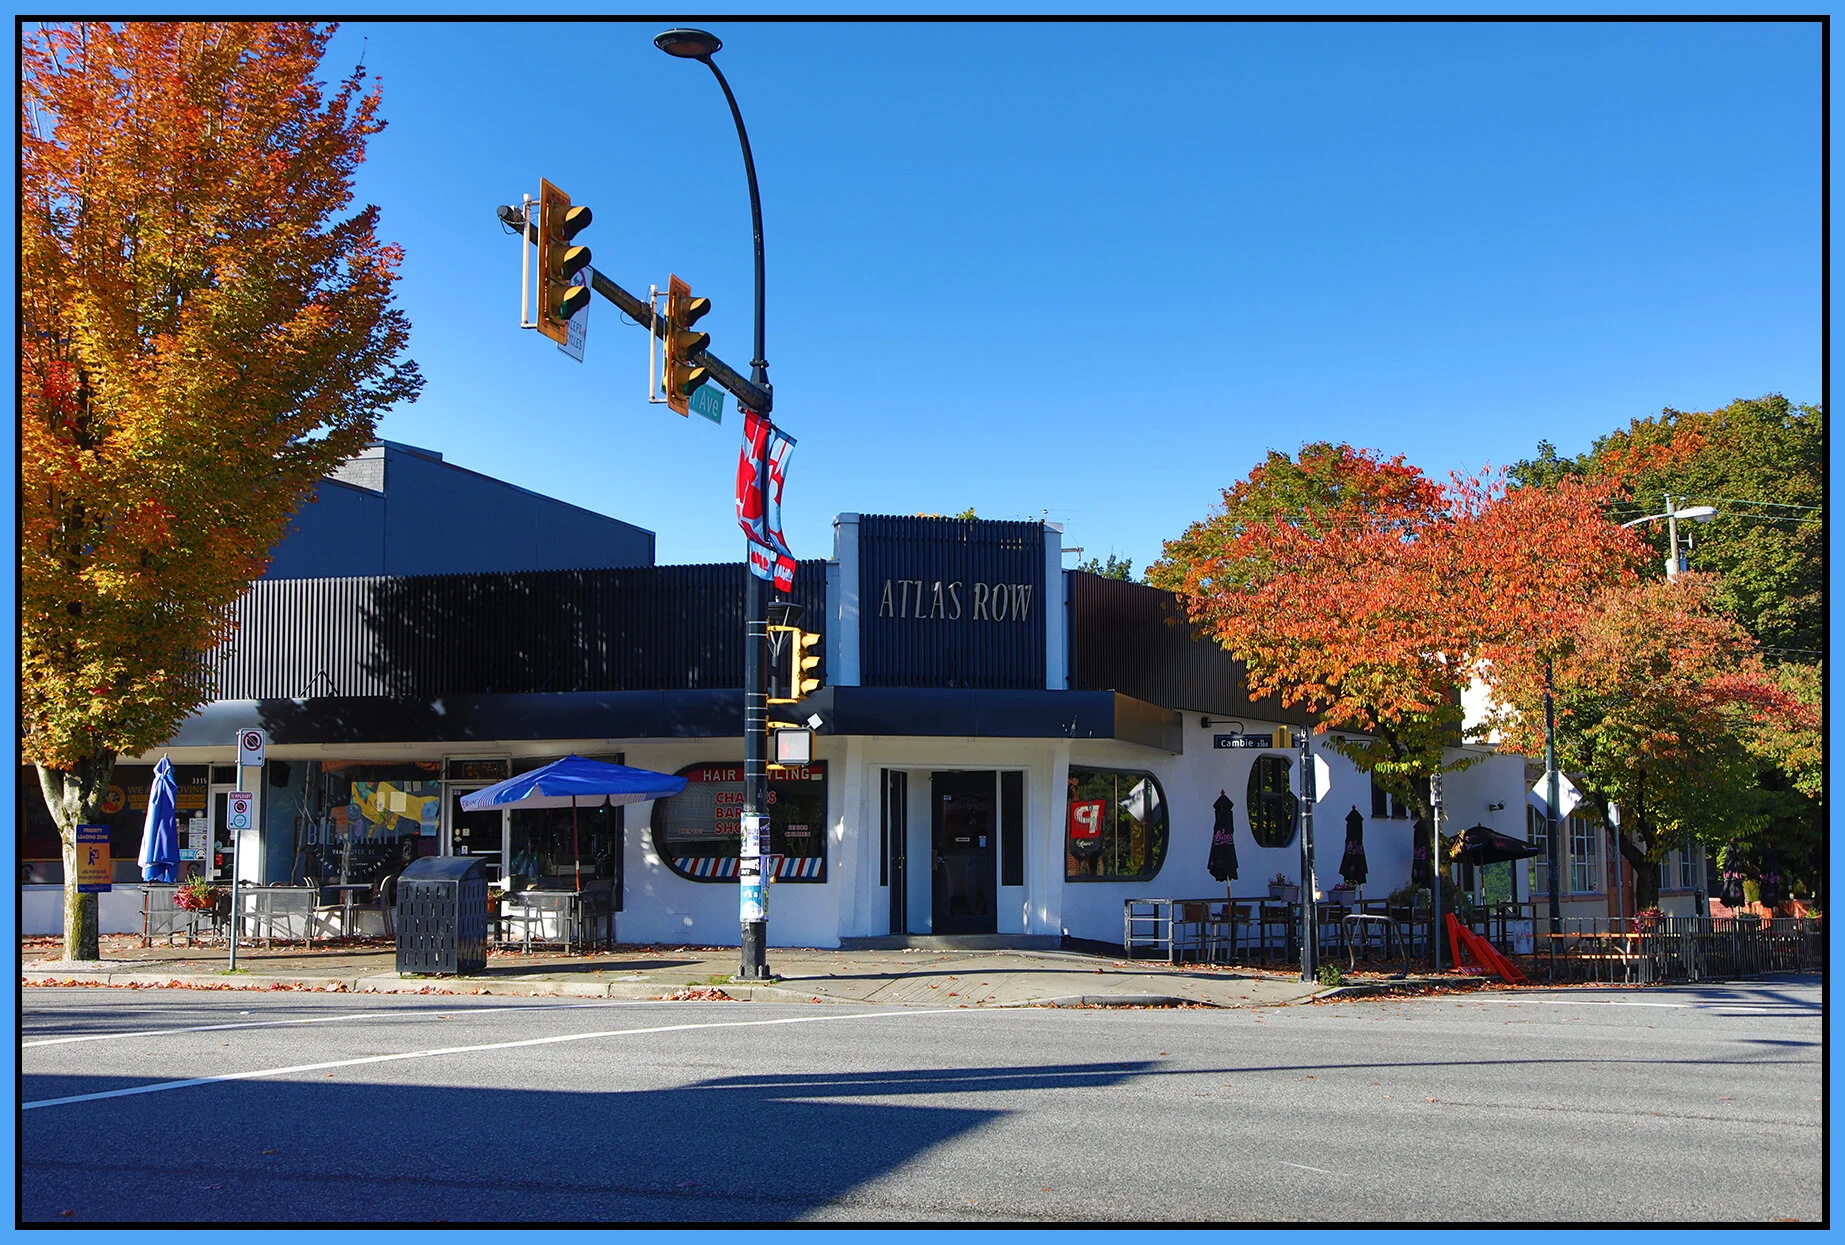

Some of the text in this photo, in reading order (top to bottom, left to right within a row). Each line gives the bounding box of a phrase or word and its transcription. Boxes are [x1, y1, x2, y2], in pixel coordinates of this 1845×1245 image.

[569, 319, 582, 333] CEPT
[568, 334, 583, 350] YCLES
[699, 390, 719, 417] Ave
[879, 579, 1032, 622] ATLAS ROW
[1221, 739, 1254, 748] Cambie
[703, 768, 810, 781] HAIR YLING
[177, 786, 206, 794] OVING
[715, 792, 777, 804] CHAS
[715, 823, 742, 834] SHO
